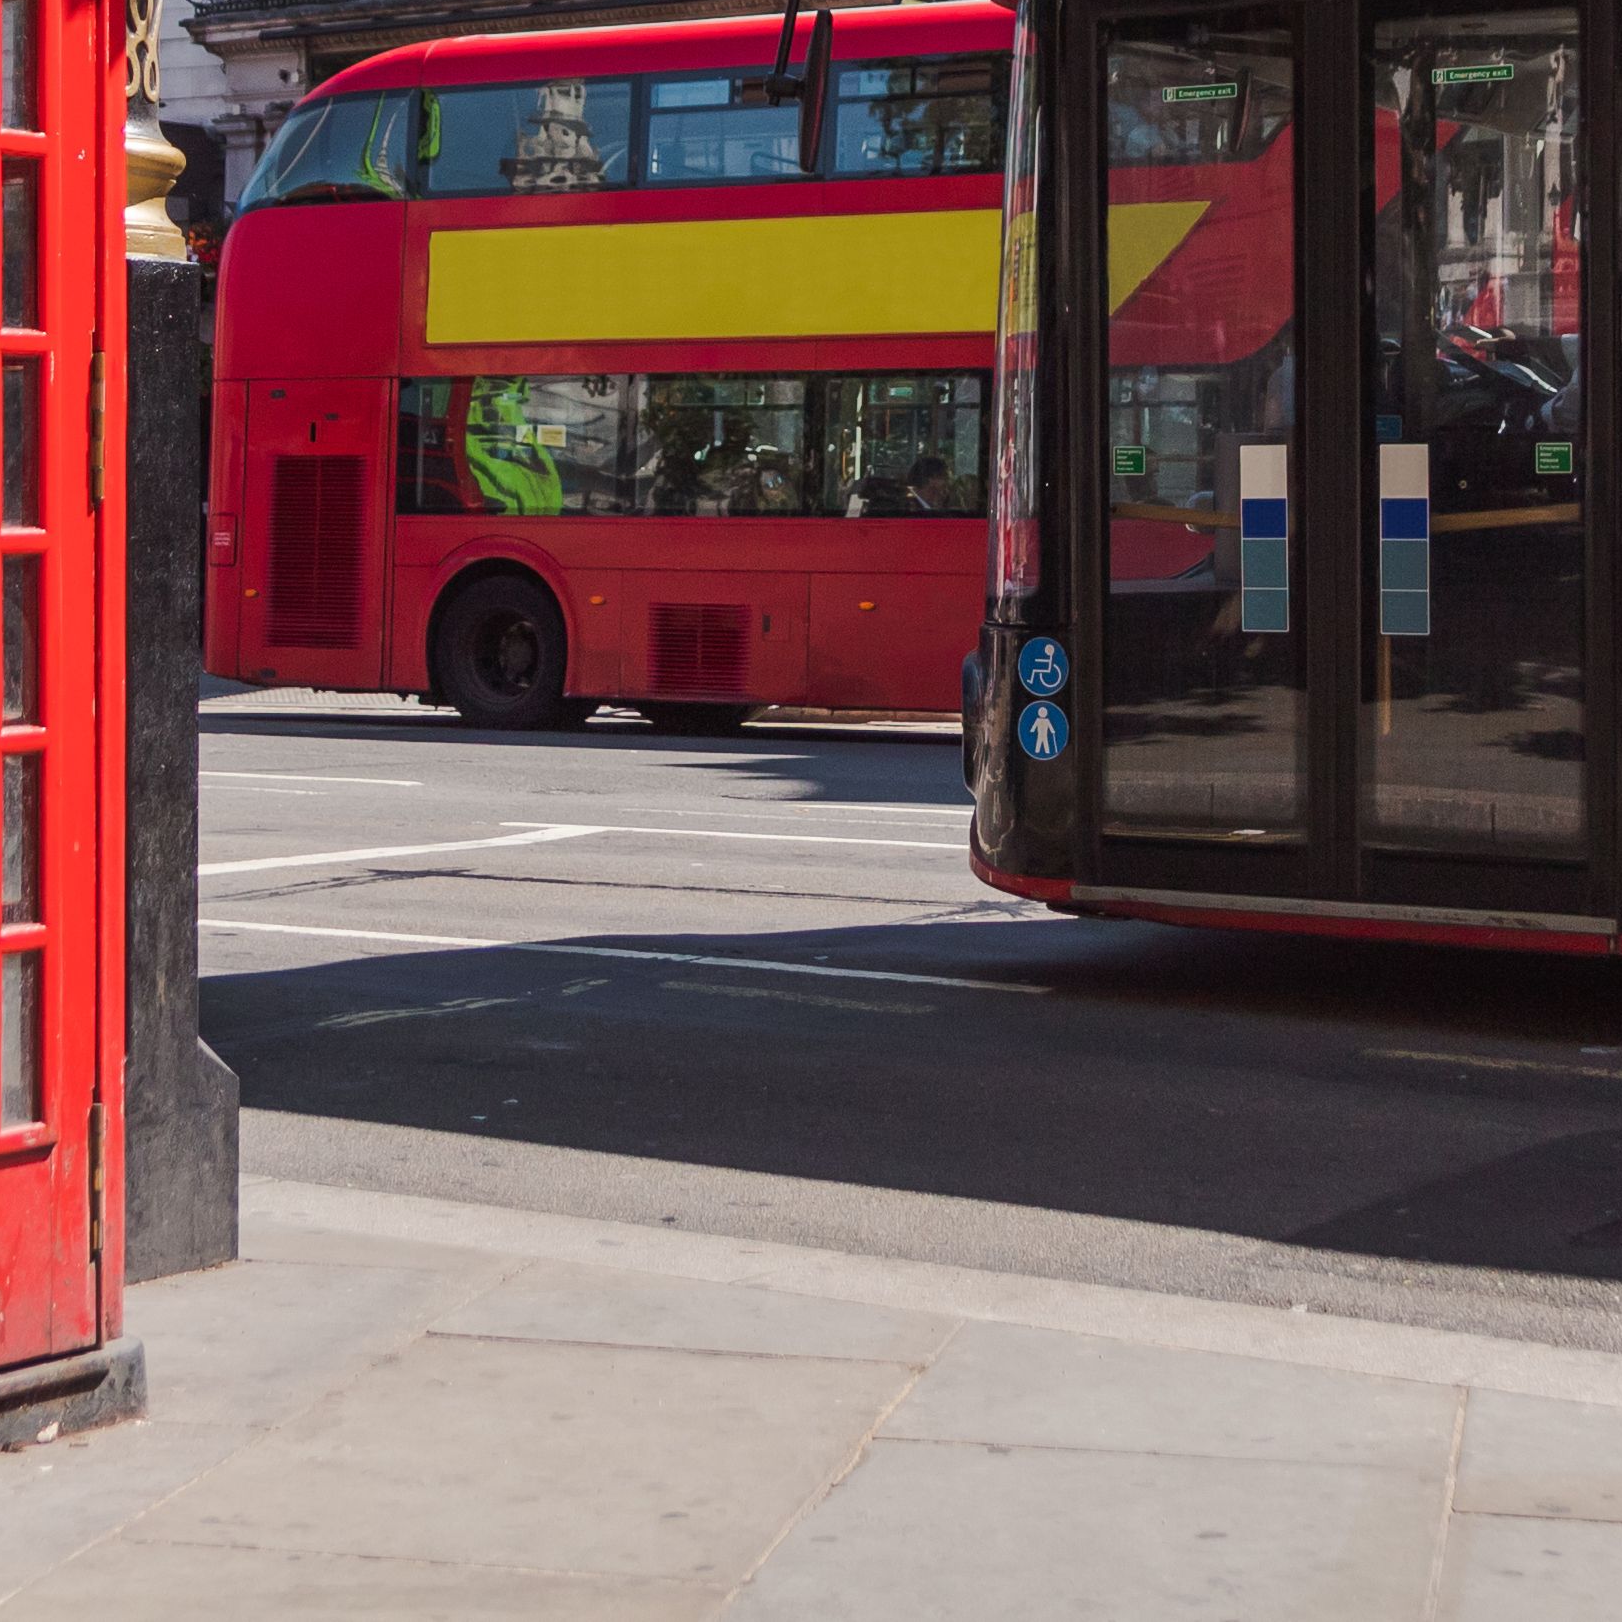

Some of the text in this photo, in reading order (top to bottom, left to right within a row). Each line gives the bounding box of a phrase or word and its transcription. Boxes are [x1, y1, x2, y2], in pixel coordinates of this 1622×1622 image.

[1449, 69, 1507, 80] Emergency exit
[1178, 89, 1216, 98] Emergency
